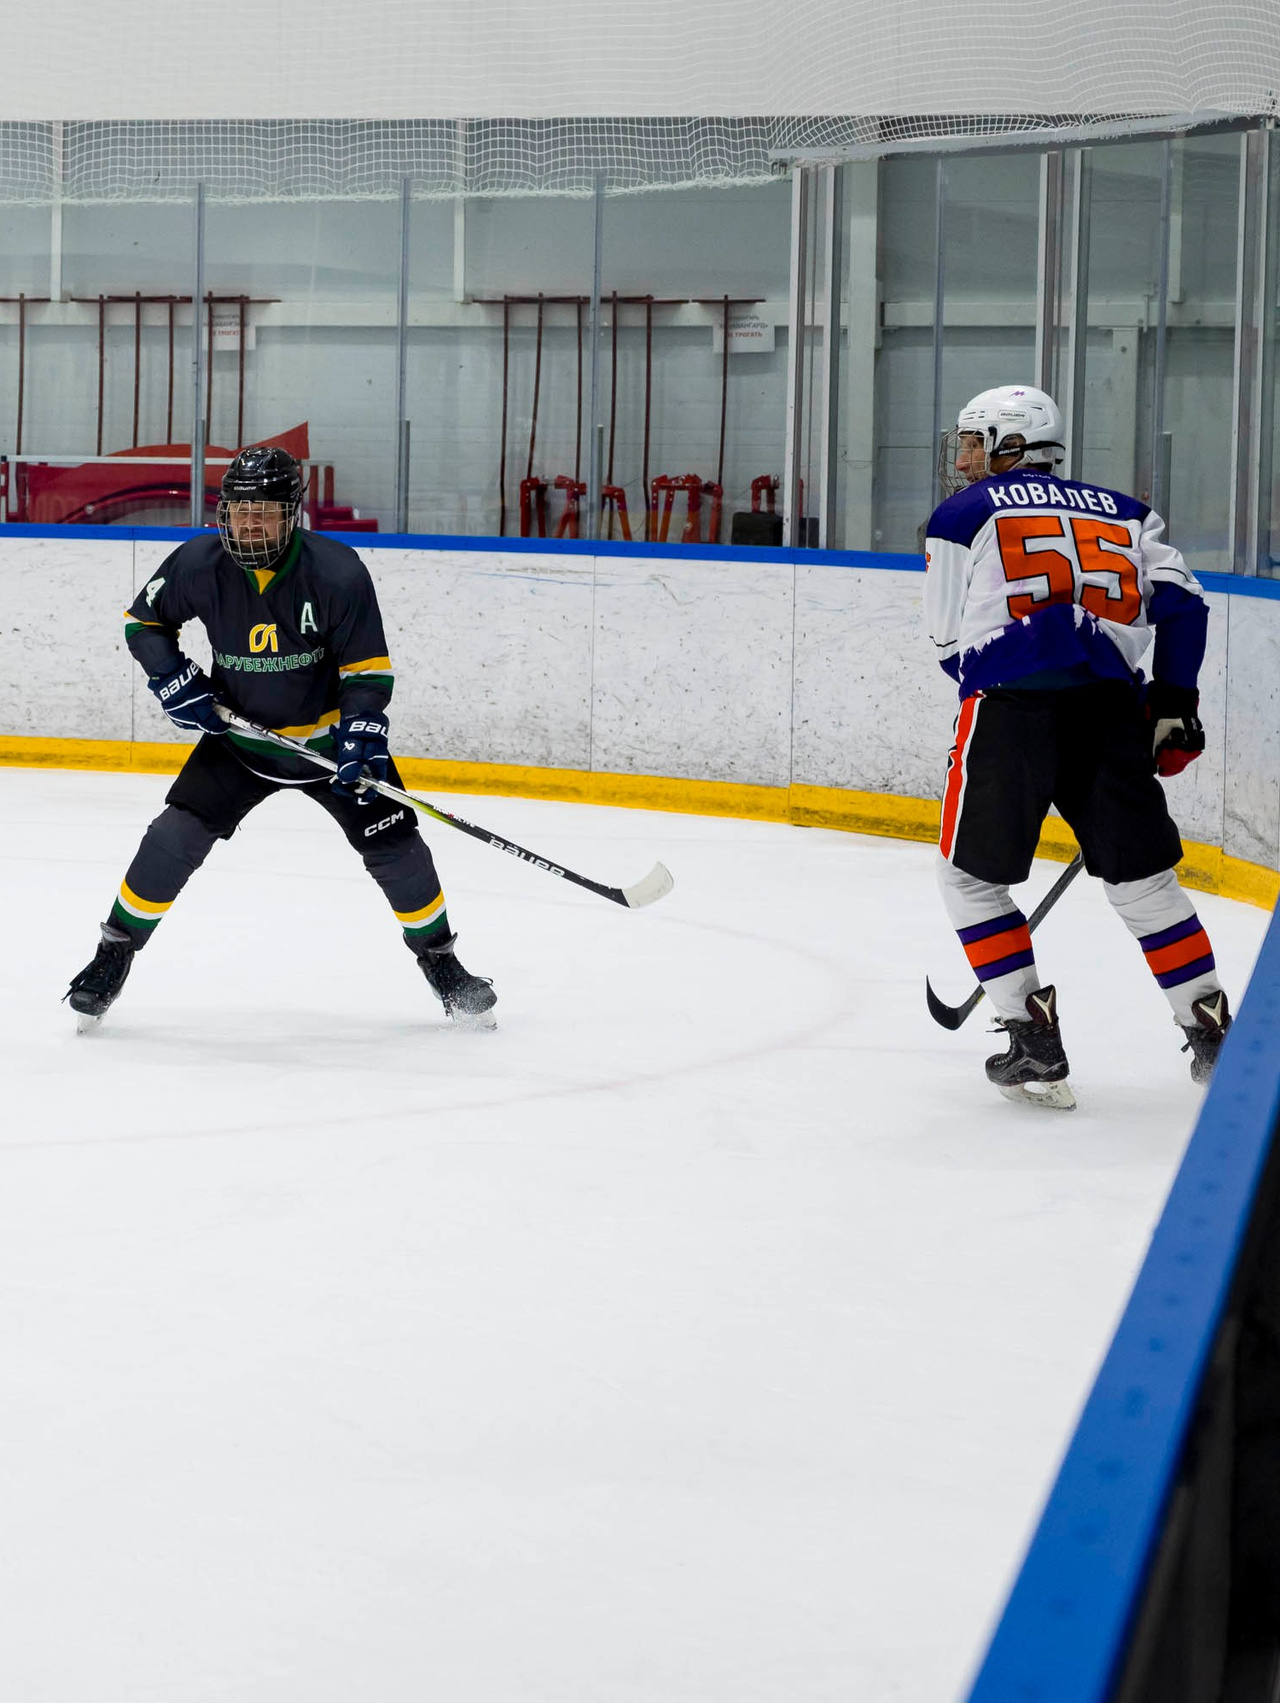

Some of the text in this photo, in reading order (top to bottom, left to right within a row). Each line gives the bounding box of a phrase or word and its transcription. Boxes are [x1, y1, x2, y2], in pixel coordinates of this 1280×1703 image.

[987, 483, 1118, 515] КОВАЛЕВ
[995, 516, 1142, 626] 55
[300, 601, 318, 634] A
[364, 809, 404, 837] CCM
